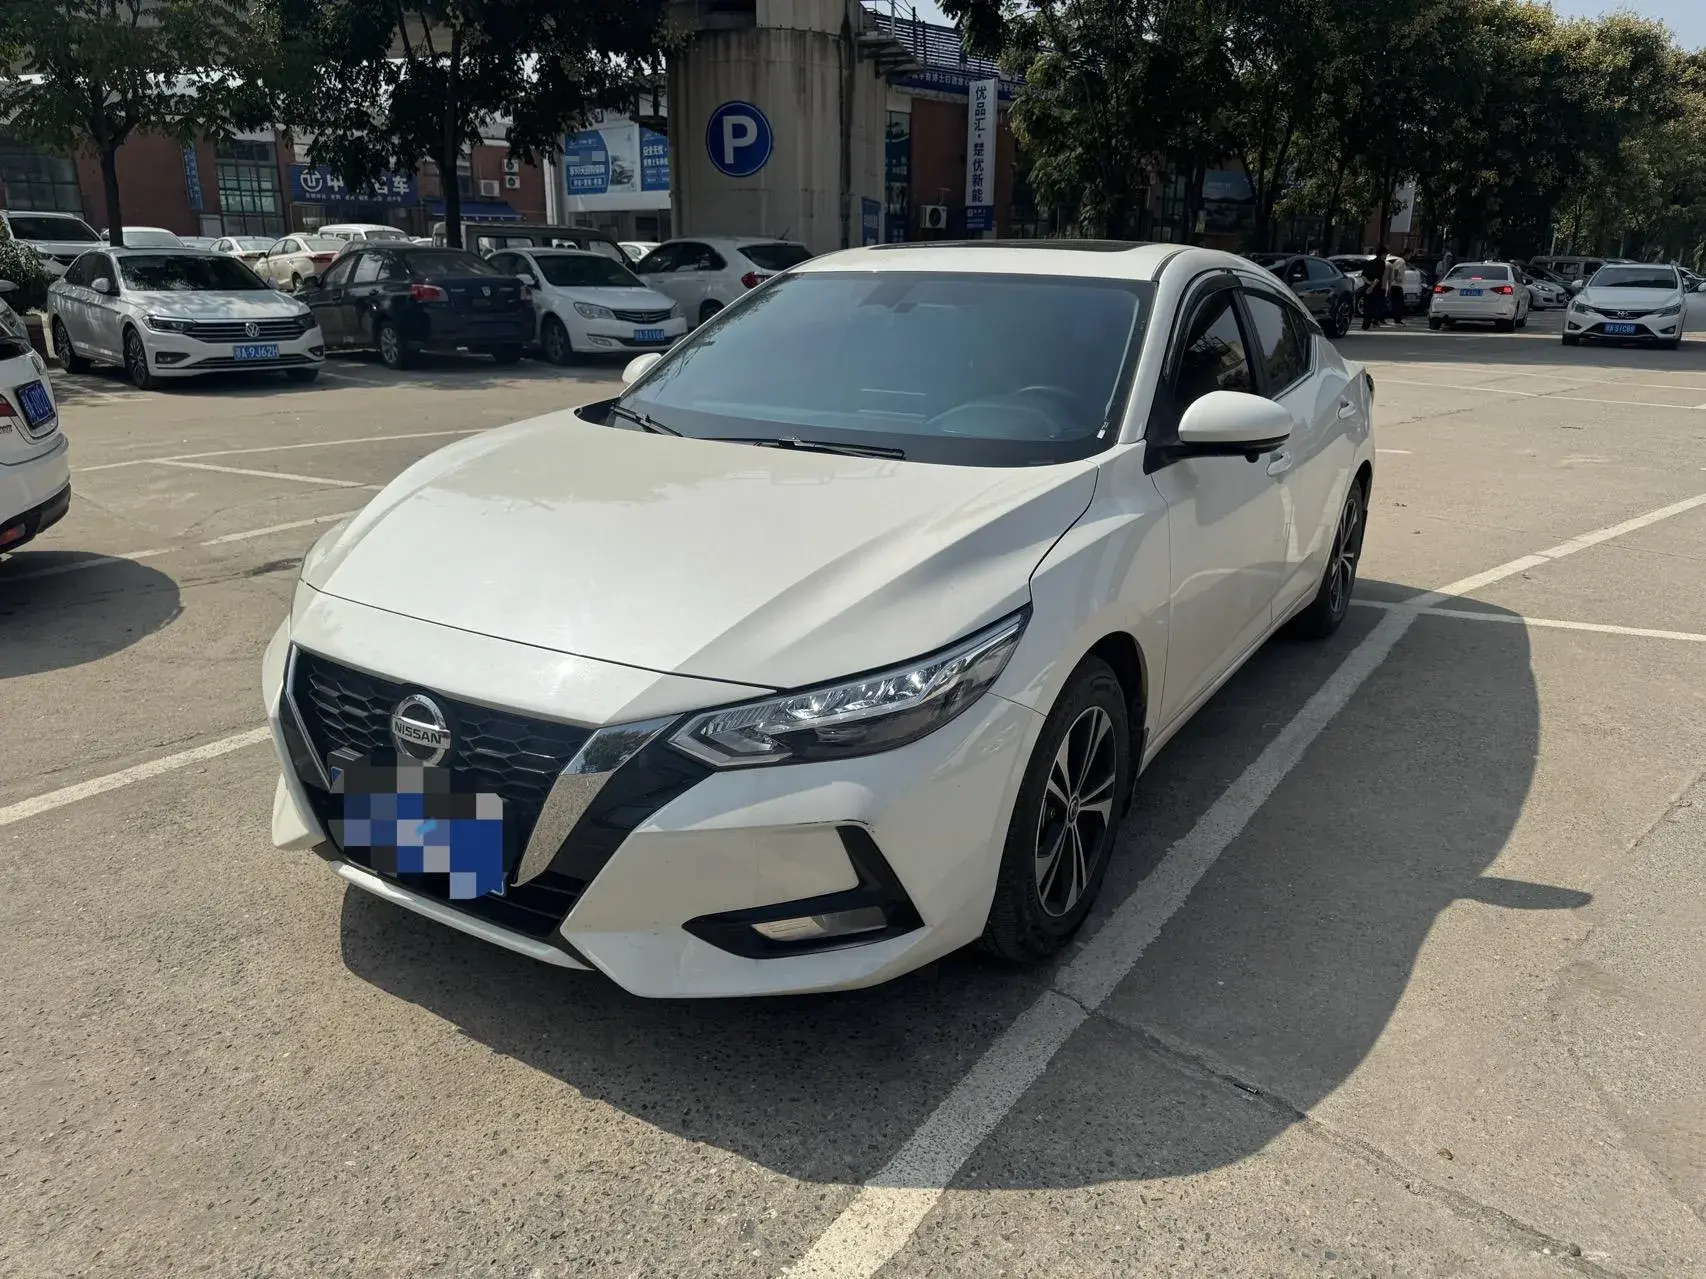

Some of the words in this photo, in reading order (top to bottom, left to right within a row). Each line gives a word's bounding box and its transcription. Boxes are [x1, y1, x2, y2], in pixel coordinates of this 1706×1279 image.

[723, 115, 758, 164] P
[971, 85, 988, 204] 优品汇·楚优新能
[326, 173, 410, 195] 中名车
[394, 722, 442, 744] NISSAN
